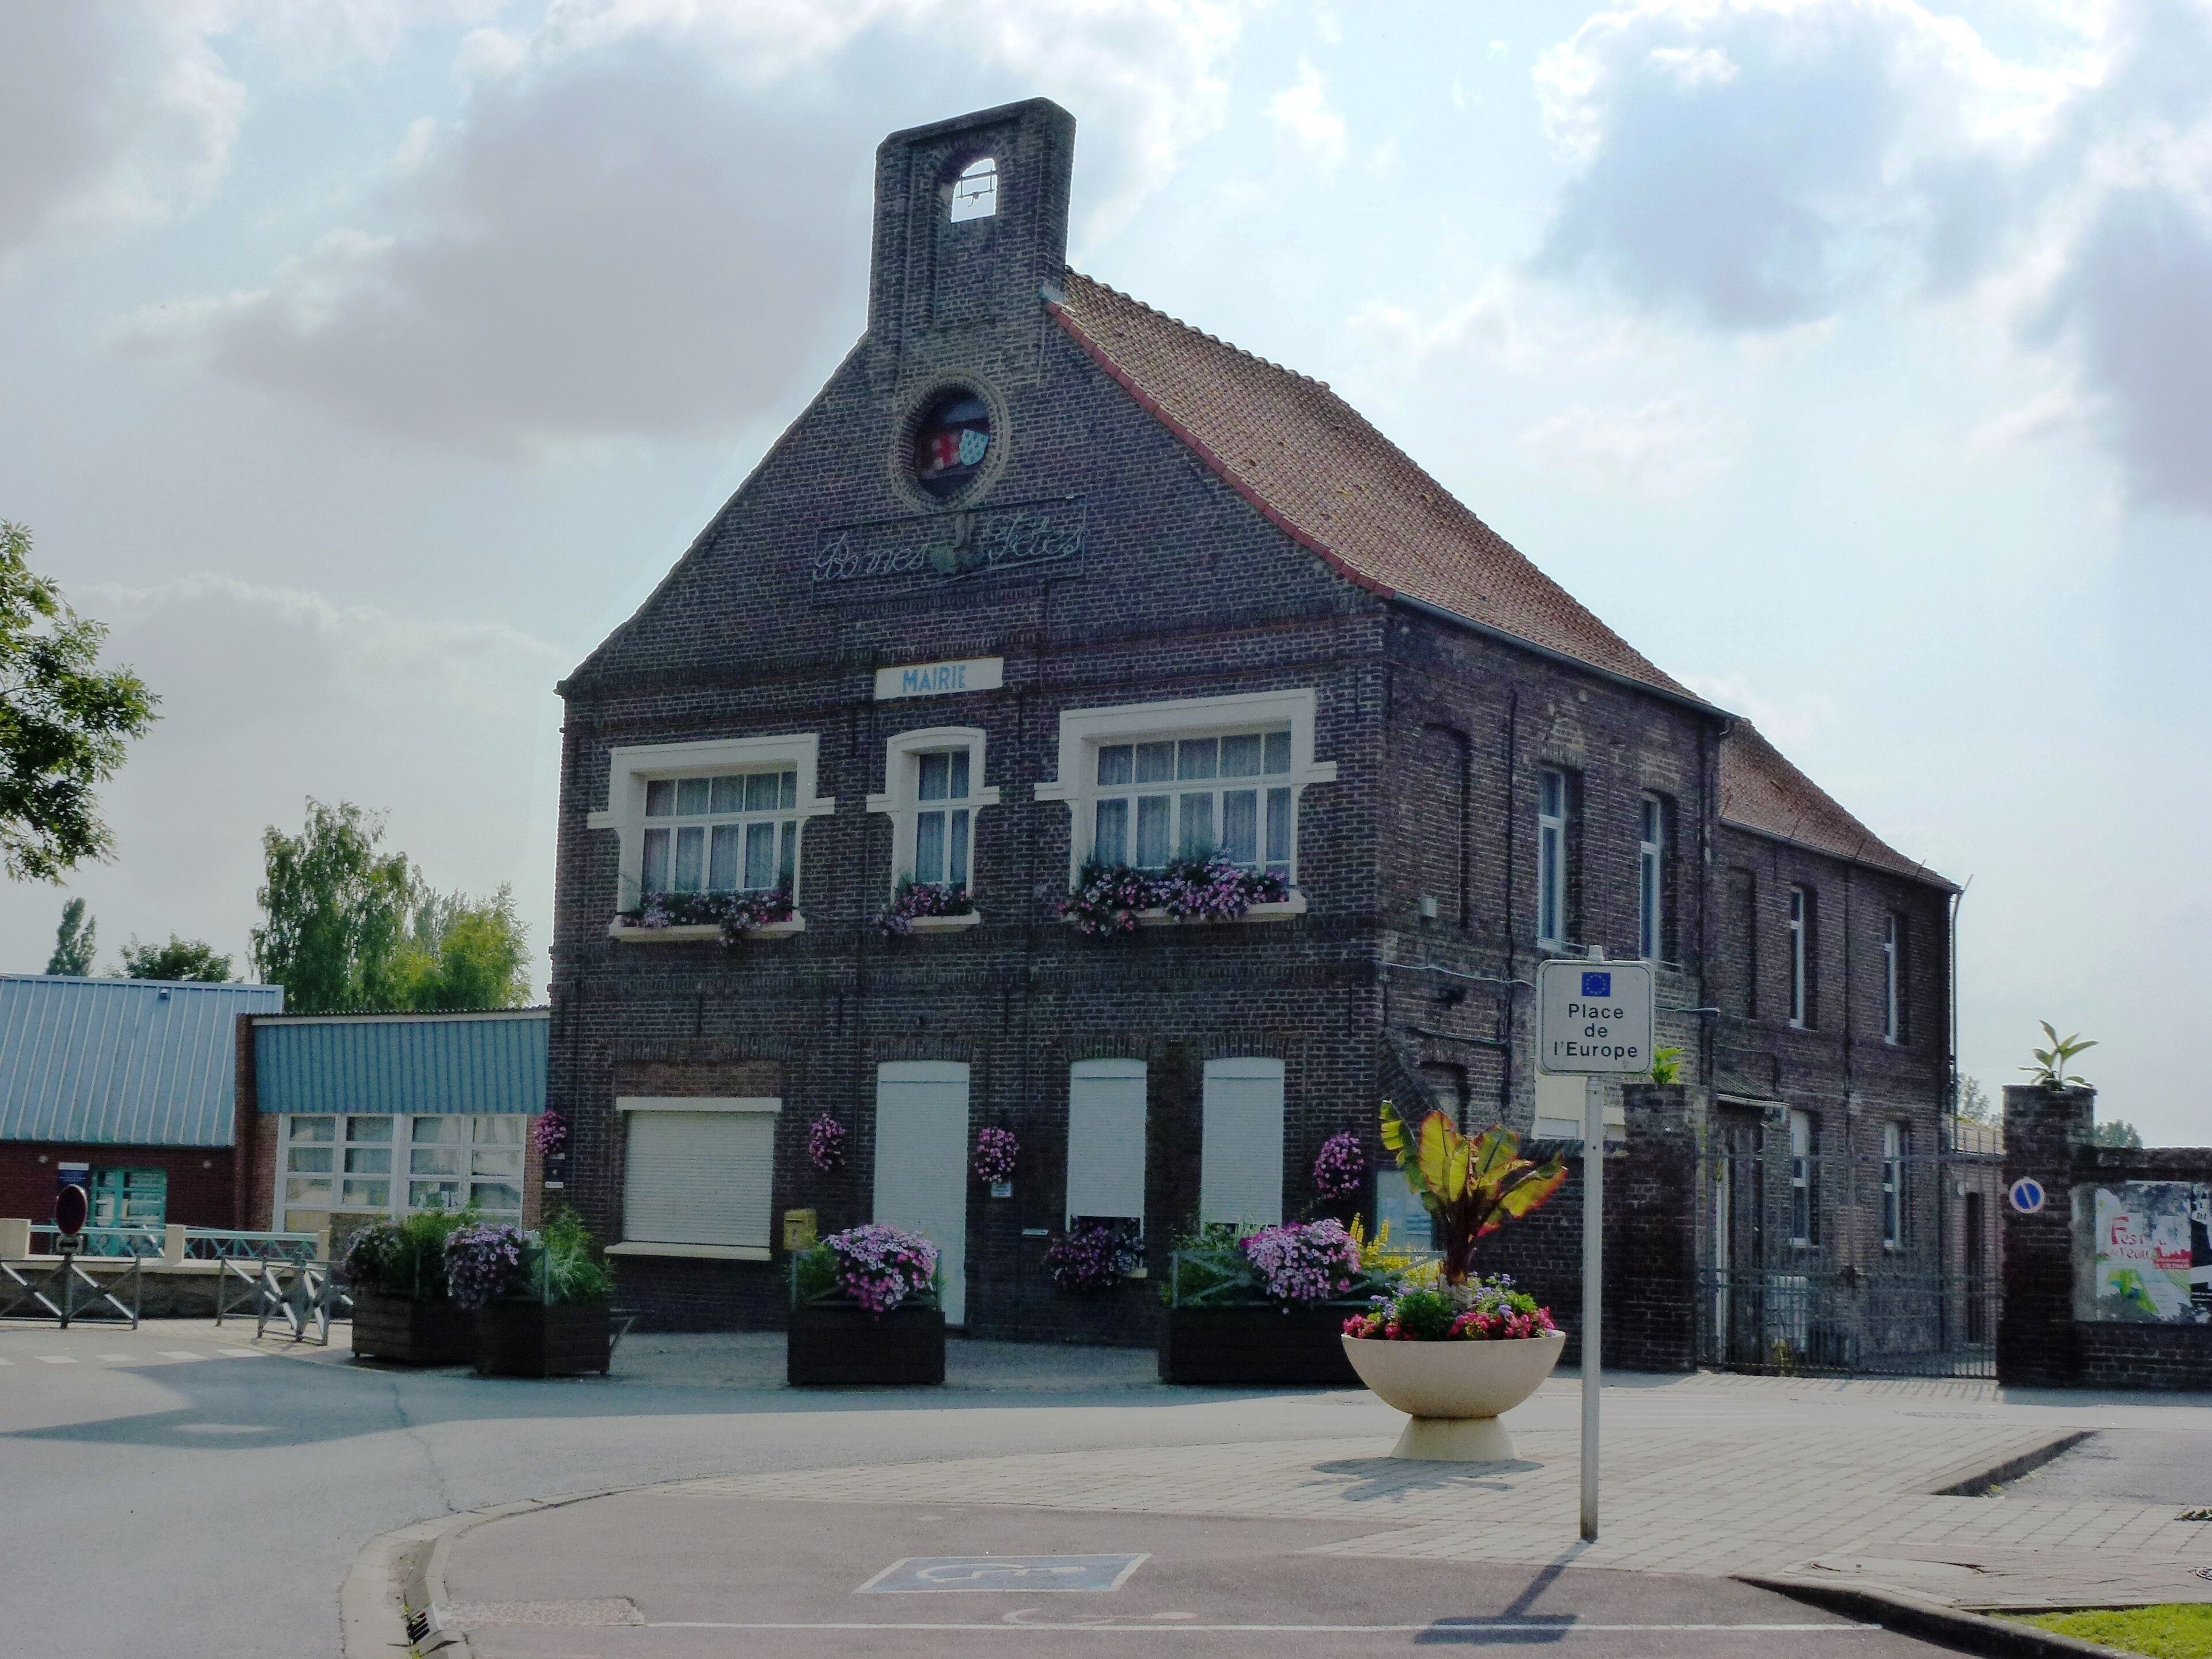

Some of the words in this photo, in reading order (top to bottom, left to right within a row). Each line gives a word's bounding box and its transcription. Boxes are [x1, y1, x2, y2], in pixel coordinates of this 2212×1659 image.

[903, 664, 966, 693] MAIRIE
[1568, 1003, 1624, 1018] Place
[1584, 1023, 1608, 1037] de
[1554, 1041, 1638, 1059] l'Europe
